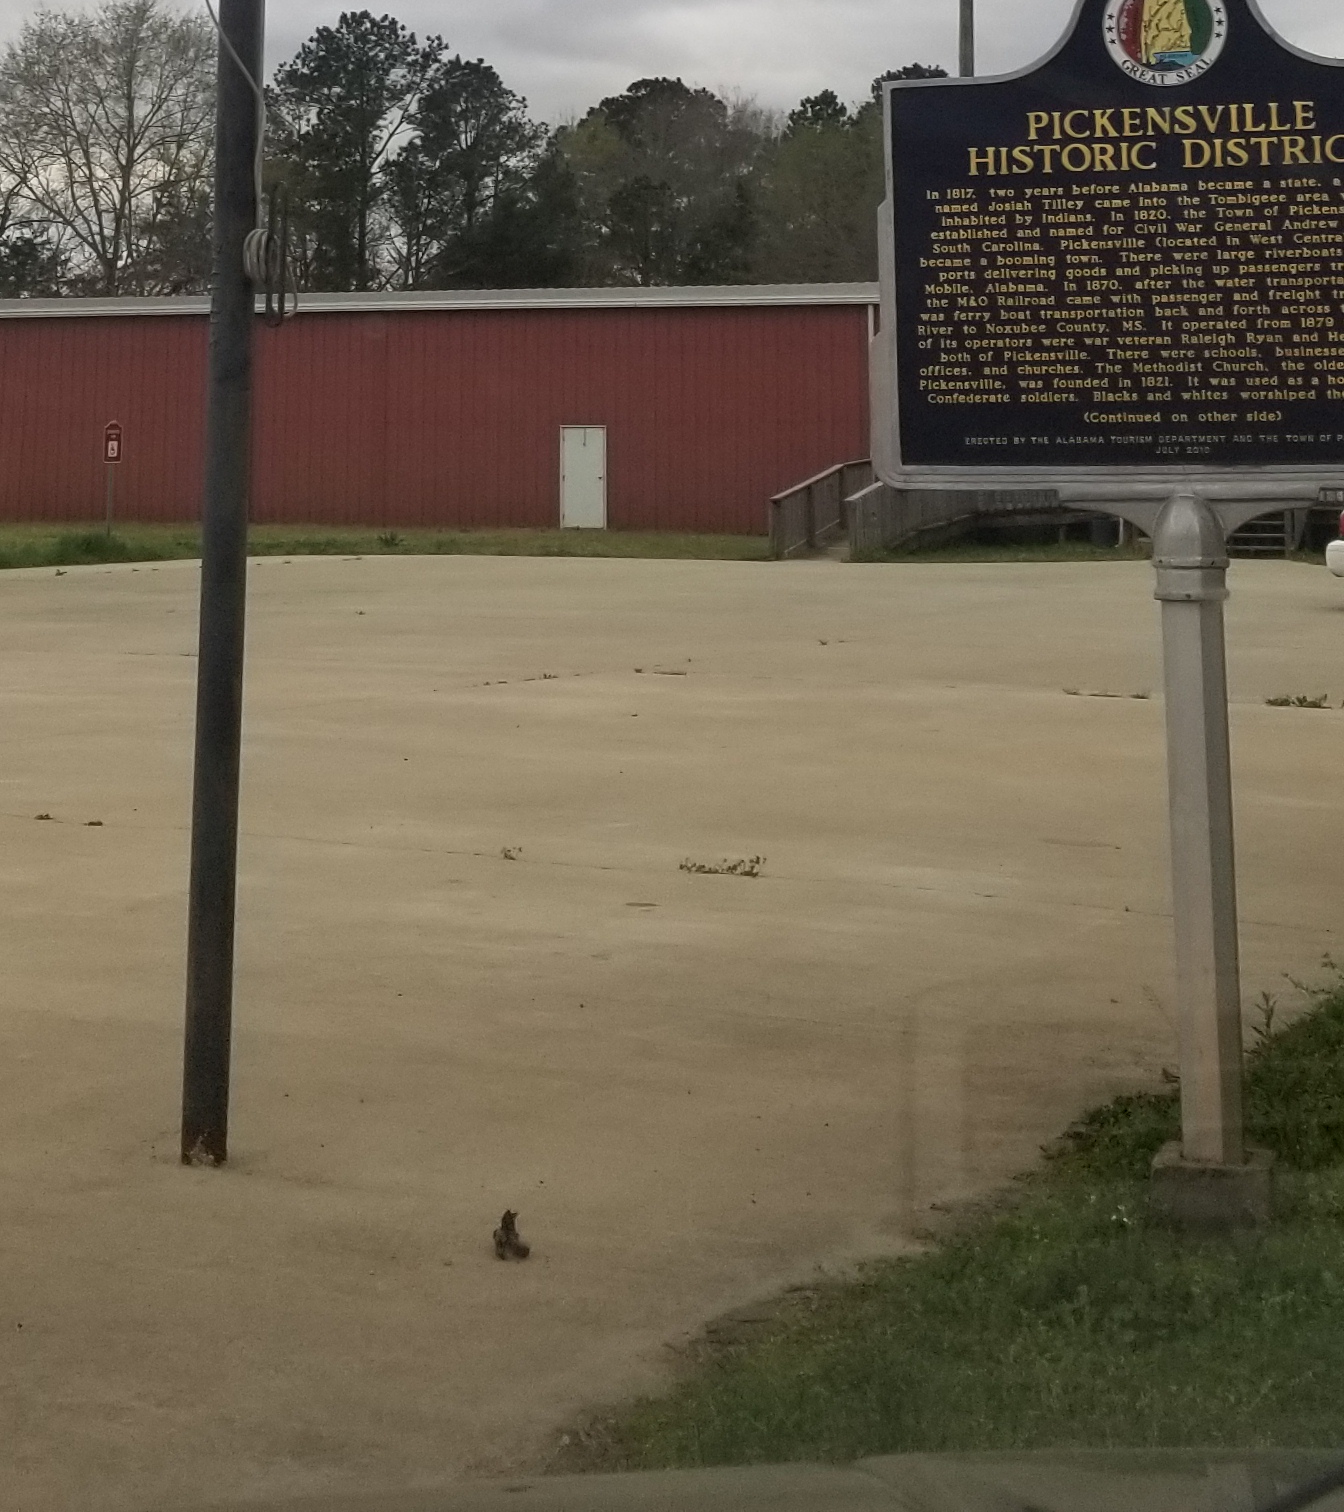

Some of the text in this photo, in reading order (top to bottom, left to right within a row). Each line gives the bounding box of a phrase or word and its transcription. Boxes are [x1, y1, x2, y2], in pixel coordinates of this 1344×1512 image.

[1121, 57, 1213, 85] GREAT SEAL
[1026, 101, 1316, 140] PICKENSVILLE
[967, 141, 1157, 176] HISTORIC
[926, 189, 940, 200] In
[988, 187, 1014, 198] two
[1024, 187, 1064, 199] years
[1072, 183, 1120, 195] before
[1128, 181, 1188, 193] Alabama
[1198, 180, 1254, 191] became
[936, 201, 978, 213] named
[988, 199, 1032, 211] Josiah
[1042, 198, 1084, 211] Tilley
[1094, 198, 1130, 208] came
[1138, 195, 1166, 206] into
[1176, 194, 1200, 205] the
[1296, 192, 1330, 201] area
[942, 213, 1006, 226] inhabited
[1110, 210, 1124, 221] In
[1184, 207, 1206, 219] the
[1216, 207, 1254, 218] Town
[1264, 205, 1278, 216] of
[930, 227, 1008, 240] established
[1016, 226, 1040, 237] and
[1050, 224, 1094, 236] named
[1102, 224, 1124, 235] for
[1134, 222, 1166, 234] Civil
[1174, 222, 1202, 233] War
[1214, 219, 1272, 232] General
[1282, 218, 1338, 230] Andrew
[932, 241, 970, 253] South
[1060, 237, 1146, 250] Pickensville
[1250, 233, 1282, 244] West
[920, 256, 972, 267] became
[996, 253, 1056, 266] booming
[1120, 251, 1162, 262] There
[1172, 251, 1208, 260] were
[1218, 248, 1254, 261] large
[1264, 246, 1342, 258] riverboats
[938, 269, 976, 283] ports
[984, 267, 1056, 280] delivering
[1066, 265, 1106, 279] goods
[1116, 264, 1140, 276] and
[1150, 263, 1202, 277] picking
[1238, 263, 1320, 275] passengers
[1064, 280, 1076, 291] In
[1134, 278, 1172, 289] after
[1182, 277, 1204, 288] the
[1214, 276, 1256, 287] water
[926, 296, 948, 308] the
[998, 294, 1054, 306] Railroad
[1066, 295, 1100, 304] came
[1110, 292, 1142, 303] with
[1152, 293, 1222, 305] passenger
[1234, 290, 1258, 301] and
[1268, 288, 1320, 302] freight
[920, 313, 944, 321] was
[954, 310, 990, 322] ferry
[1000, 309, 1030, 320] boat
[1040, 306, 1144, 320] transportation
[1154, 305, 1188, 316] back
[1198, 304, 1224, 316] and
[1234, 303, 1270, 315] forth
[1282, 305, 1330, 314] across
[918, 324, 954, 335] River
[986, 322, 1046, 334] Noxubee
[1182, 318, 1246, 332] operated
[1256, 318, 1292, 329] from
[1302, 316, 1334, 328] 1879
[964, 337, 1032, 350] operators
[1042, 338, 1074, 346] were
[1084, 337, 1110, 346] war
[1116, 334, 1172, 345] veteran
[1182, 332, 1236, 346] Raleigh
[1246, 332, 1282, 345] Ryan
[1292, 331, 1318, 342] and
[940, 351, 970, 362] both
[1108, 348, 1148, 359] There
[1160, 350, 1194, 358] were
[984, 364, 1008, 375] and
[1098, 362, 1122, 373] The
[1134, 361, 1202, 373] Methodist
[1282, 360, 1304, 371] the
[1018, 380, 1044, 388] was
[1052, 376, 1108, 388] founded
[1208, 377, 1236, 386] was
[1246, 374, 1278, 385] used
[928, 392, 1010, 403] Confederate
[1094, 390, 1138, 401] Blacks
[1146, 390, 1172, 401] and
[1180, 389, 1228, 400] whites
[1240, 388, 1316, 402] worshiped
[1084, 411, 1282, 423] (Continued on other side)
[1013, 436, 1026, 445] BY
[1031, 436, 1049, 445] THE
[1056, 436, 1105, 444] ALABAMA
[1110, 436, 1153, 444] TOURISM
